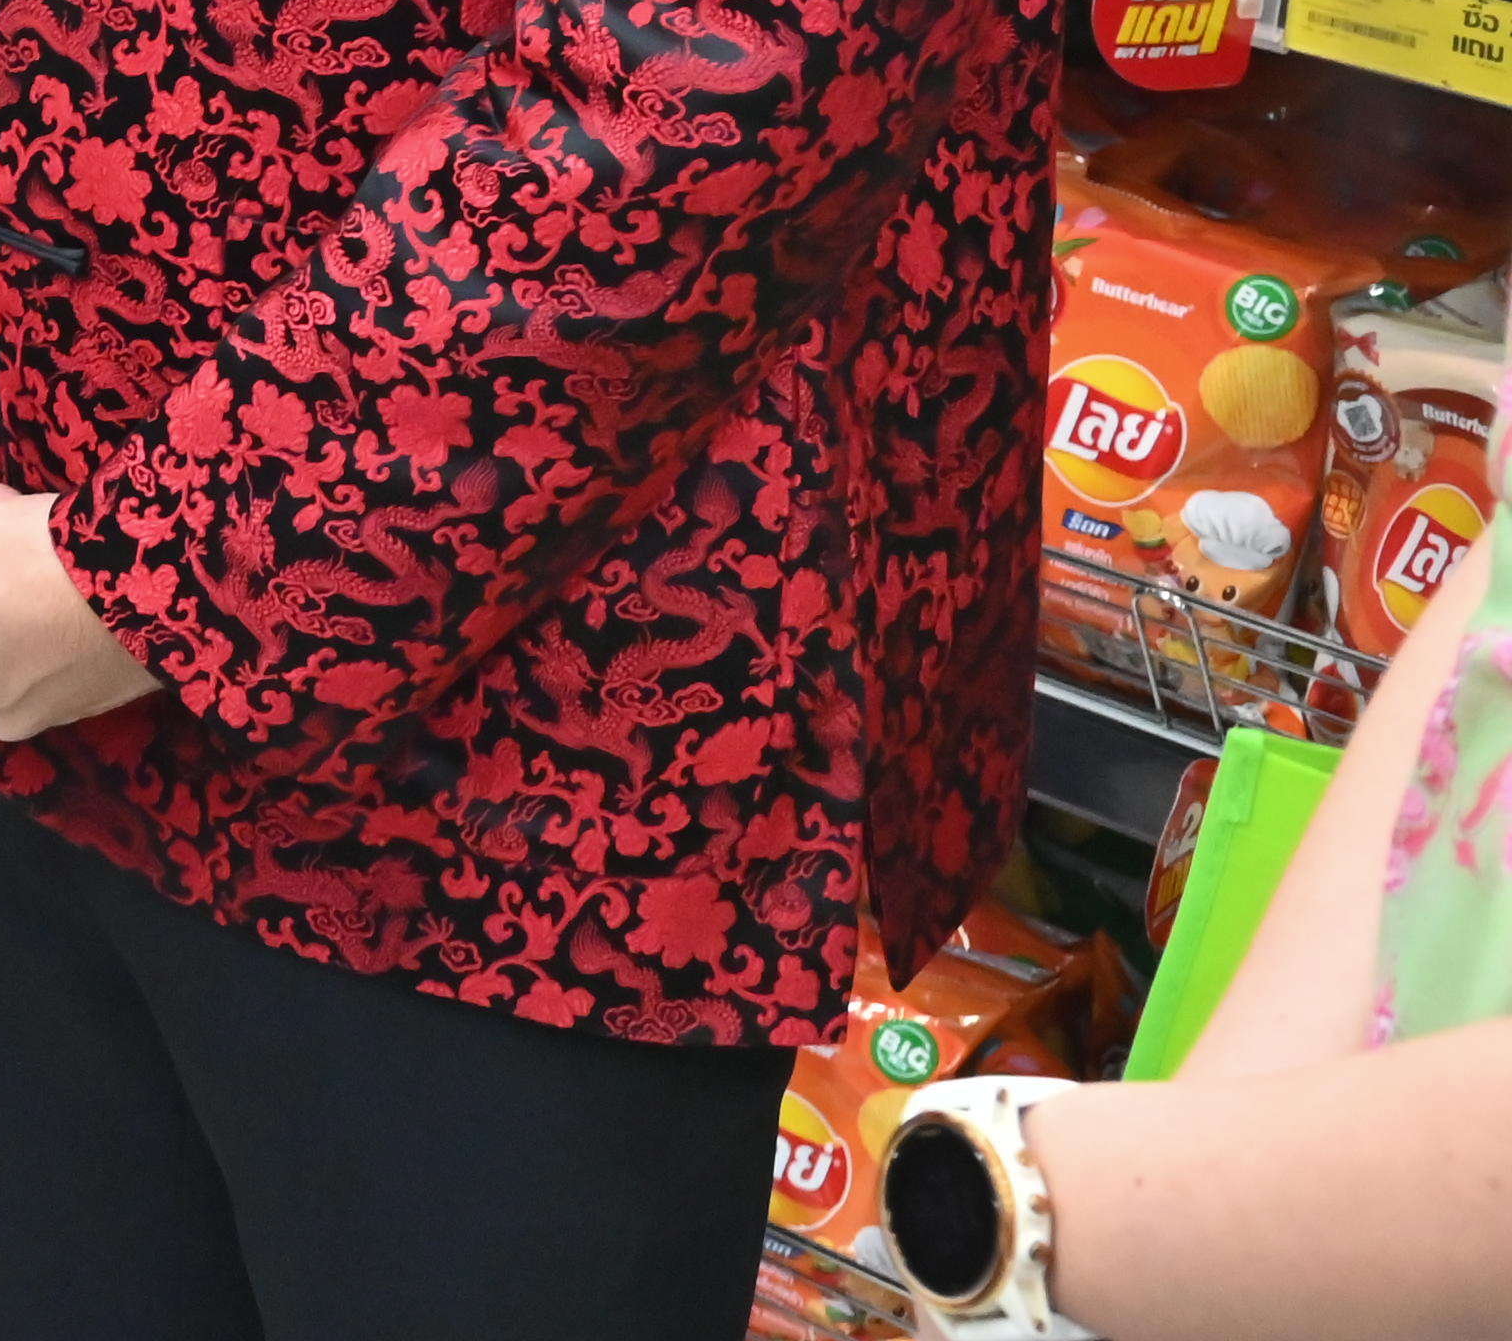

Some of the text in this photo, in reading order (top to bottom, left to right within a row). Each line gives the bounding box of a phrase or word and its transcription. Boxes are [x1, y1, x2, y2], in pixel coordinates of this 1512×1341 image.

[1451, 34, 1504, 65] แถม
[1091, 275, 1188, 320] Butterbear
[1233, 284, 1287, 329] BIG
